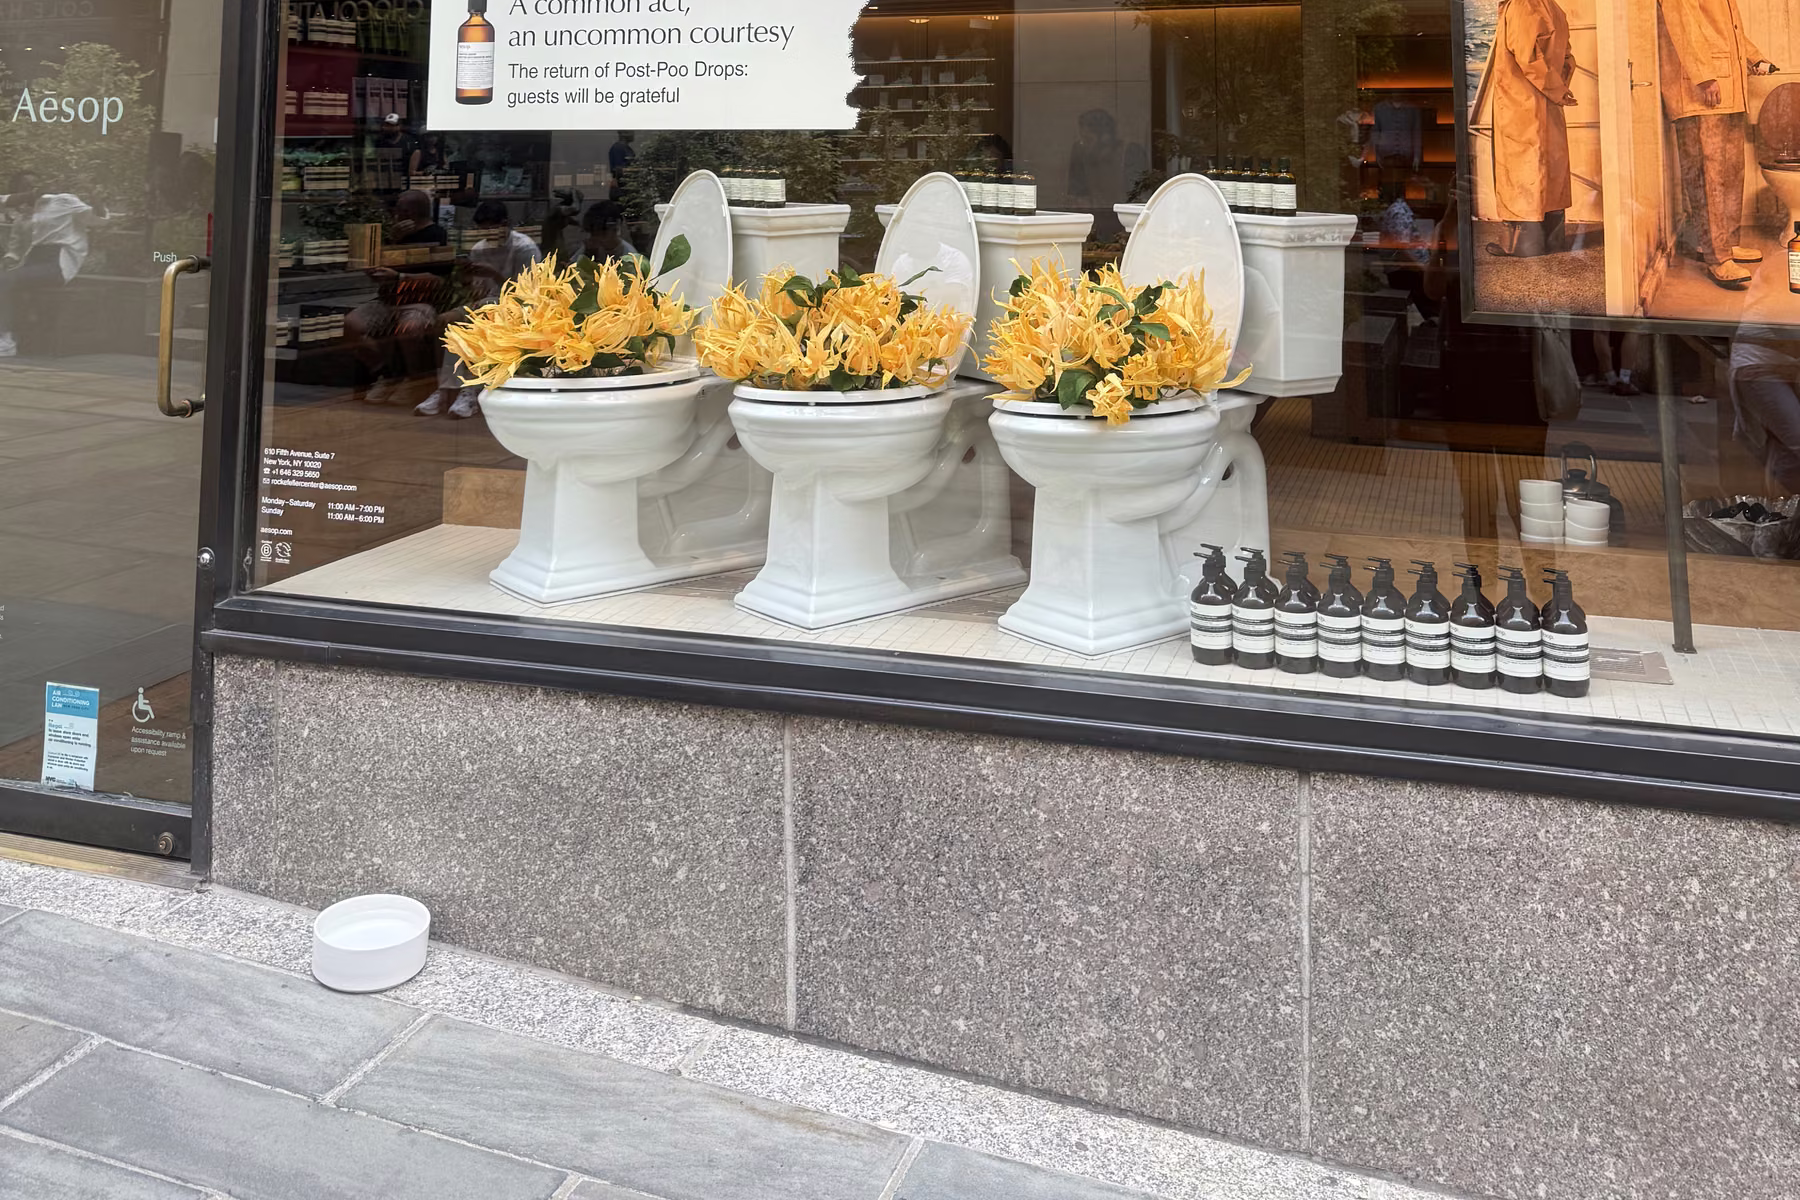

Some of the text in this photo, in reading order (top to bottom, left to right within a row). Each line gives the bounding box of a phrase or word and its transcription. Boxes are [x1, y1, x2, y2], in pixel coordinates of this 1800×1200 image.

[508, 22, 795, 50] an uncommon courtesy
[508, 63, 538, 79] The
[543, 64, 589, 79] return
[594, 62, 610, 78] of
[615, 61, 689, 78] Post-Poo
[695, 60, 749, 80] Drops:
[507, 87, 680, 108] guests will be grateful
[11, 87, 124, 135] Aēsop
[153, 251, 177, 263] Push
[290, 450, 313, 458] Avenue,
[314, 451, 330, 459] Suite
[263, 457, 277, 465] New
[277, 458, 292, 467] York,
[304, 461, 322, 469] 10020
[261, 506, 284, 516] Sunday
[327, 502, 344, 510] 11:00
[374, 505, 384, 513] PM
[327, 512, 343, 520] 11:00
[373, 515, 384, 523] PM
[260, 527, 293, 535] aesop.com
[131, 725, 187, 740] Accessibility ramp &
[131, 736, 186, 749] assistance available
[145, 748, 167, 756] request
